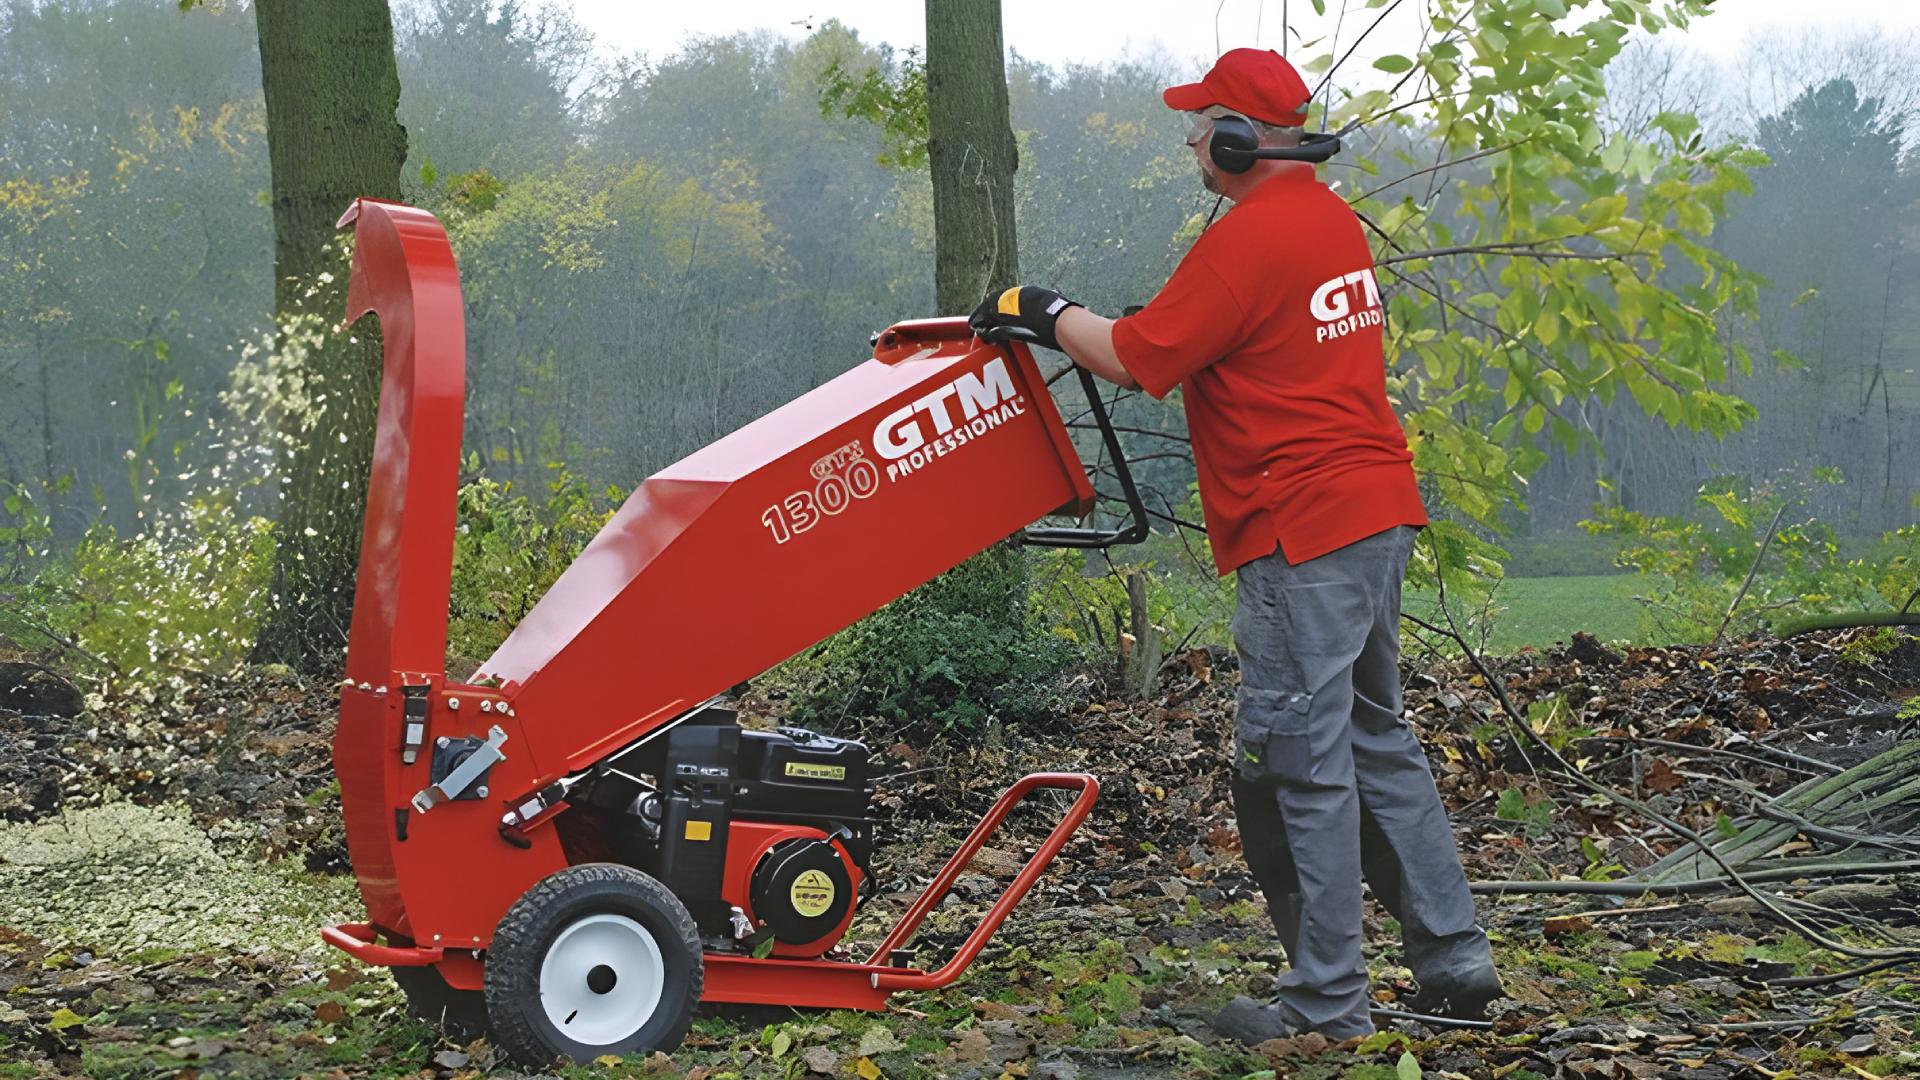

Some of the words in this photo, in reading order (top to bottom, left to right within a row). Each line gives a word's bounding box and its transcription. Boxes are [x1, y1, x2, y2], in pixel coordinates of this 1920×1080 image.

[872, 356, 1017, 460] GTM
[886, 398, 1025, 483] PROFESSIONAL
[761, 458, 879, 544] 1300
